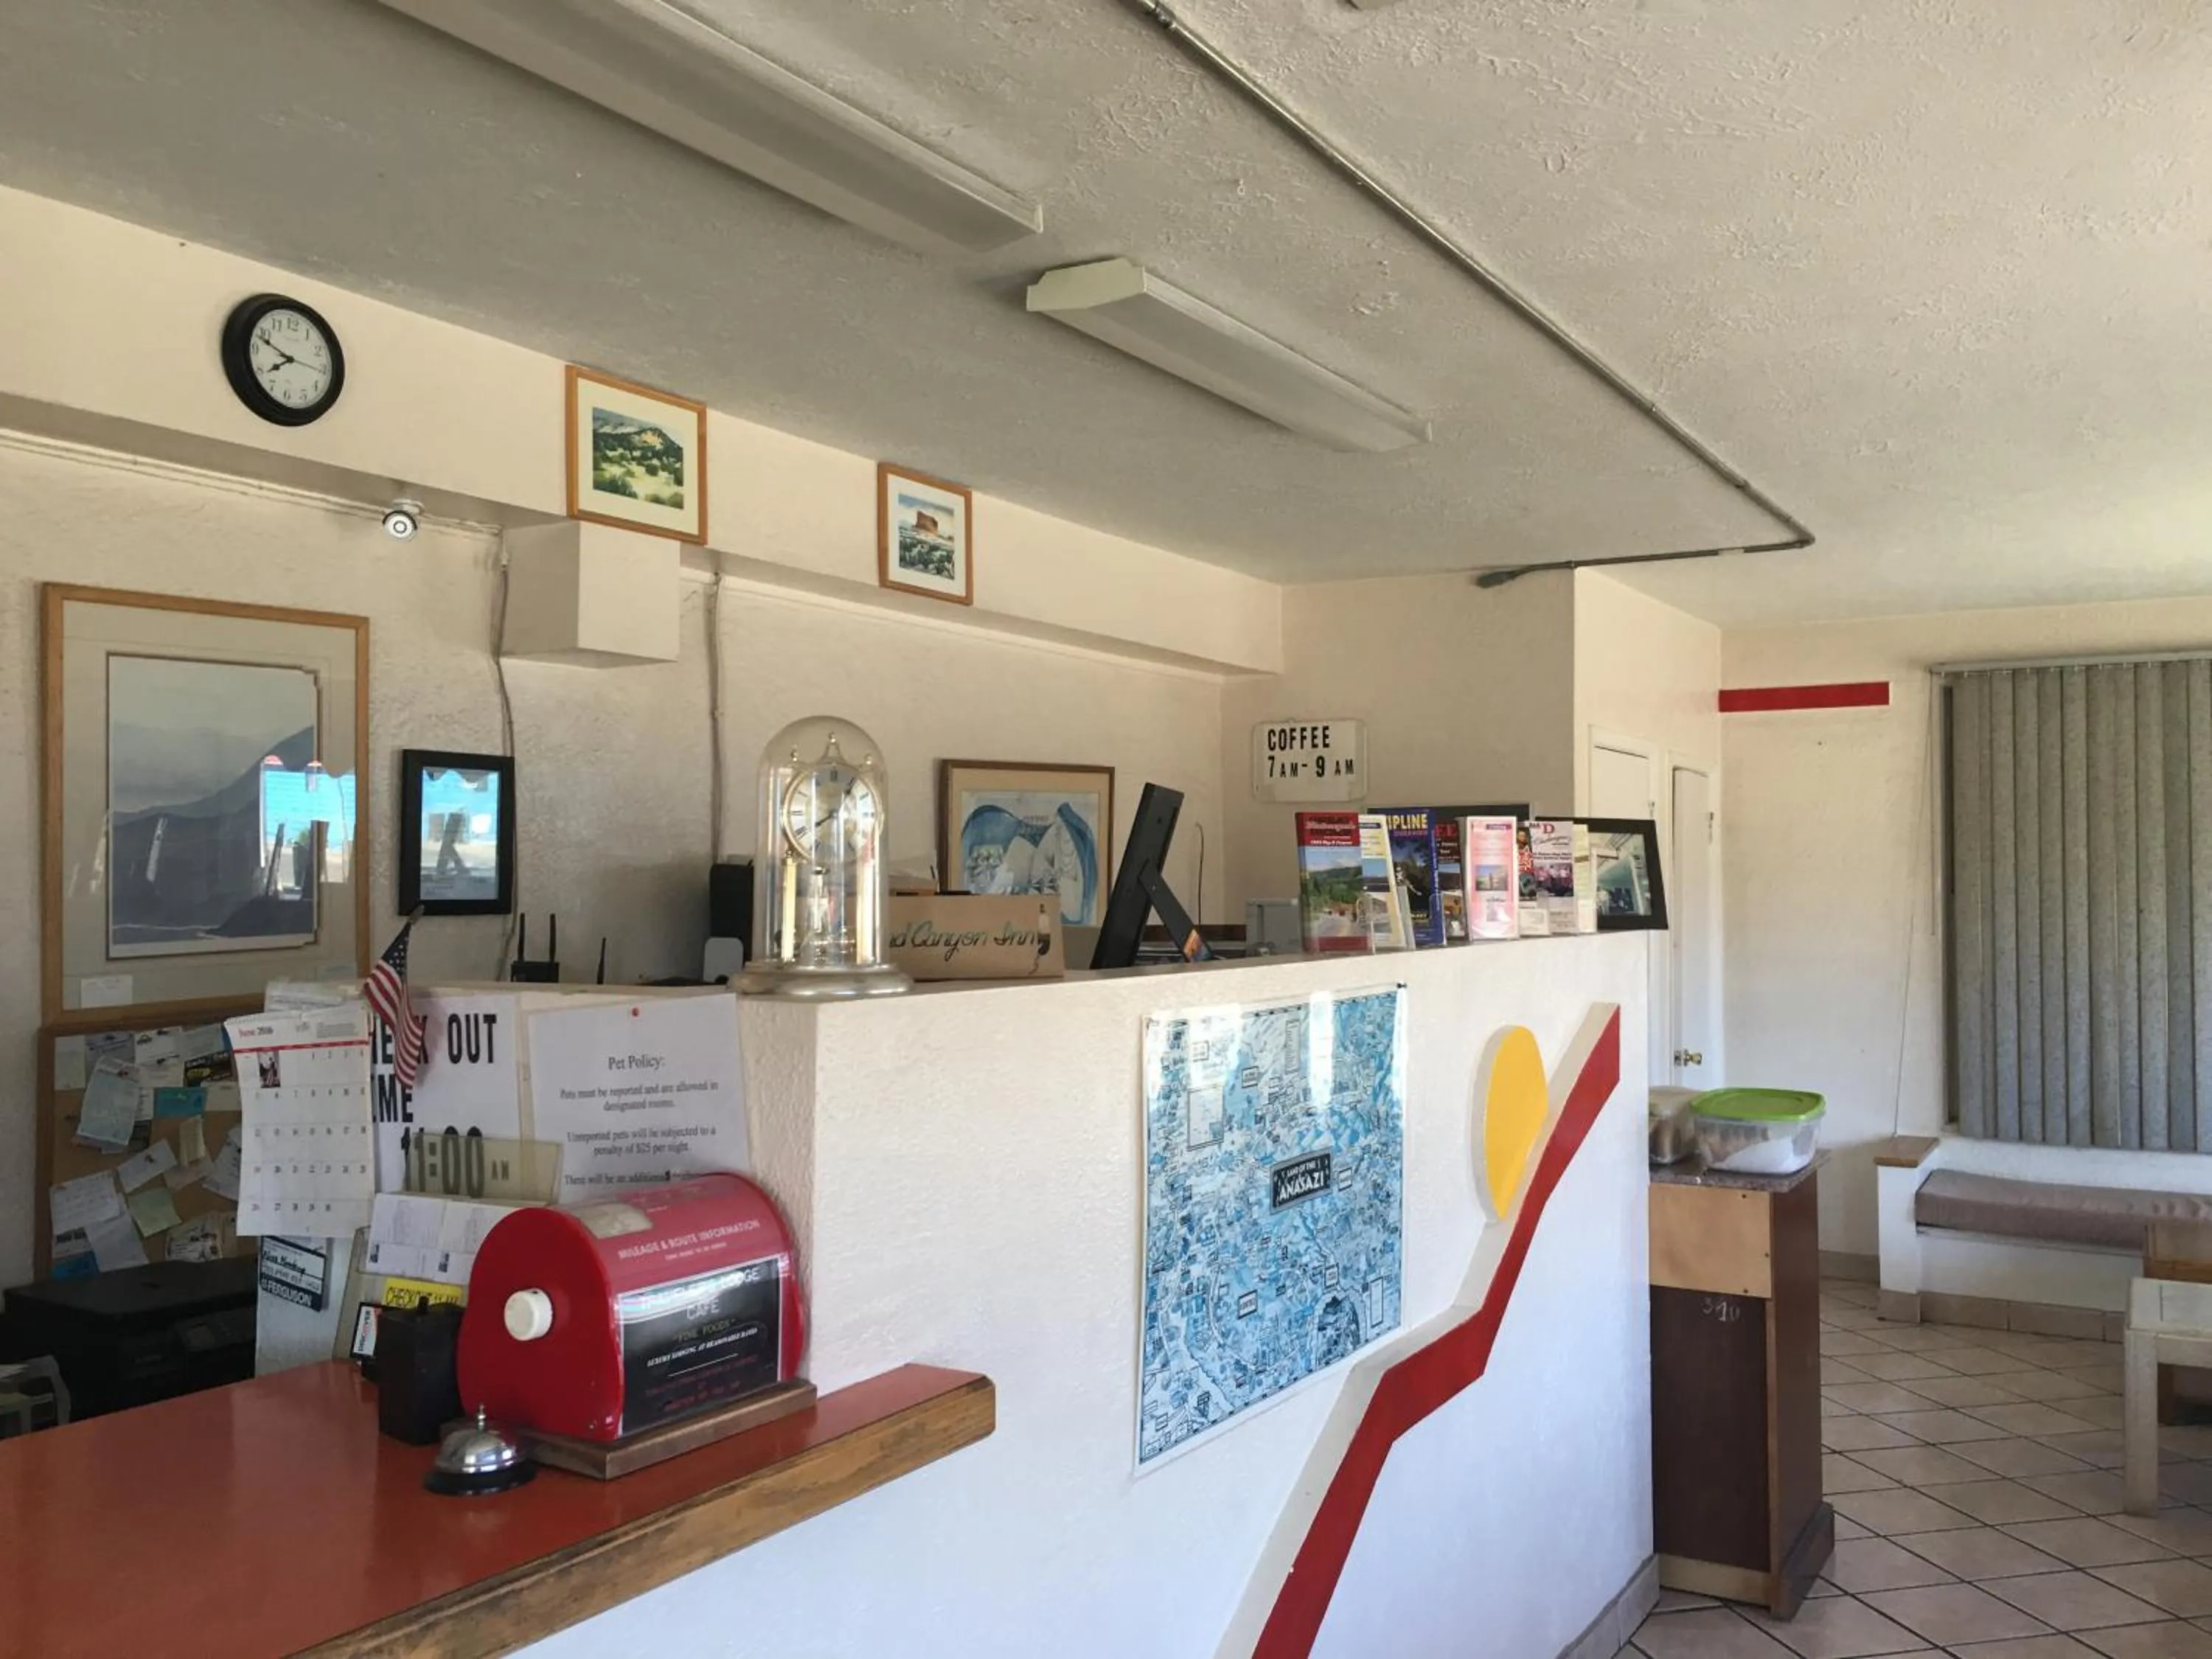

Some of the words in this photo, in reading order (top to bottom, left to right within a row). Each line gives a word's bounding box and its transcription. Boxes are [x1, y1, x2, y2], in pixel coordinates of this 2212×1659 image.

[288, 318, 299, 332] 12
[1267, 726, 1330, 751] COFFEE
[911, 921, 989, 961] Canyon
[448, 1012, 497, 1064] OUT
[608, 1057, 626, 1070] Pet
[1280, 1171, 1324, 1201] ANASAZI
[669, 1233, 699, 1249] ROUTE
[699, 1219, 761, 1242] INFORMATION
[686, 1299, 720, 1320] CAFE
